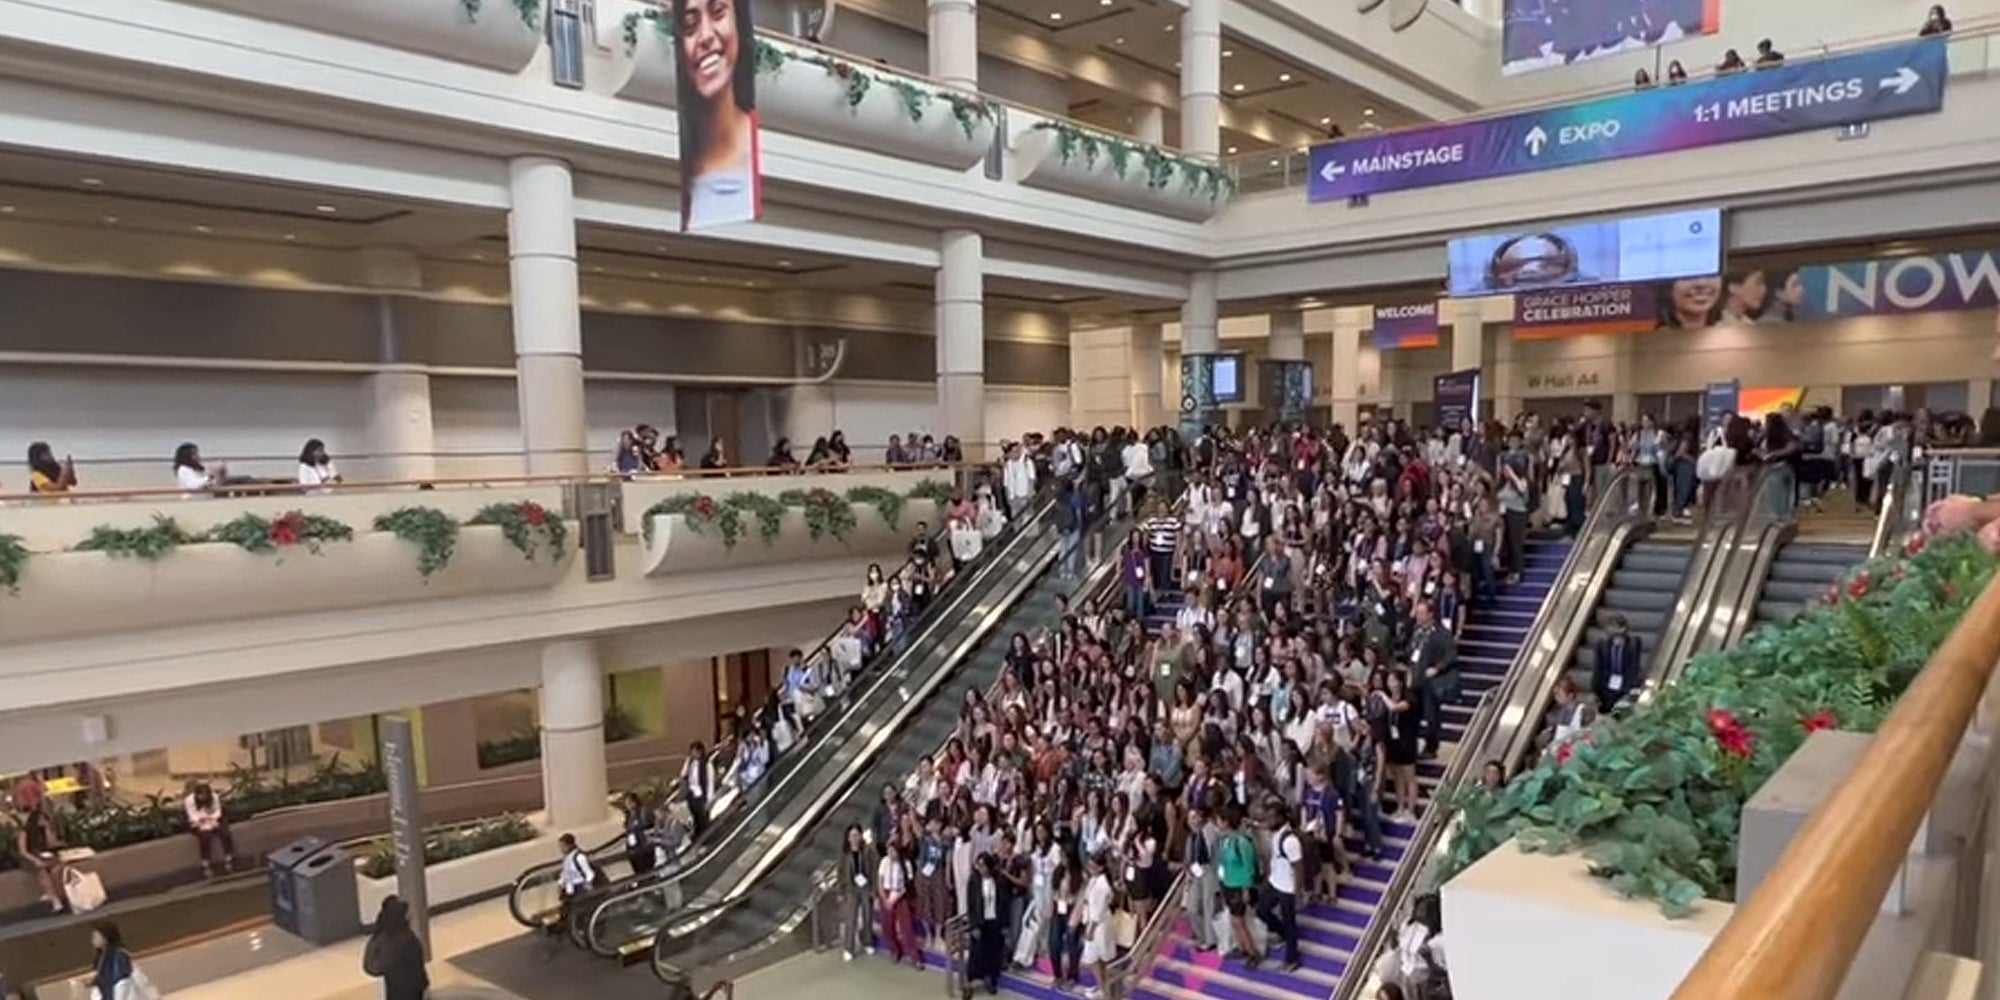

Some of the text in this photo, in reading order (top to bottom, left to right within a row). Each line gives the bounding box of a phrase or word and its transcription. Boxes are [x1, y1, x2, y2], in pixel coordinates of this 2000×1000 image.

[1694, 78, 1863, 122] 1:1 MEETINGS
[1559, 119, 1620, 145] EXPO
[1352, 143, 1463, 175] MAINSTAGE
[1825, 252, 2000, 313] NOW
[1376, 304, 1434, 319] WELCOME
[1523, 302, 1631, 322] CELEBRATION
